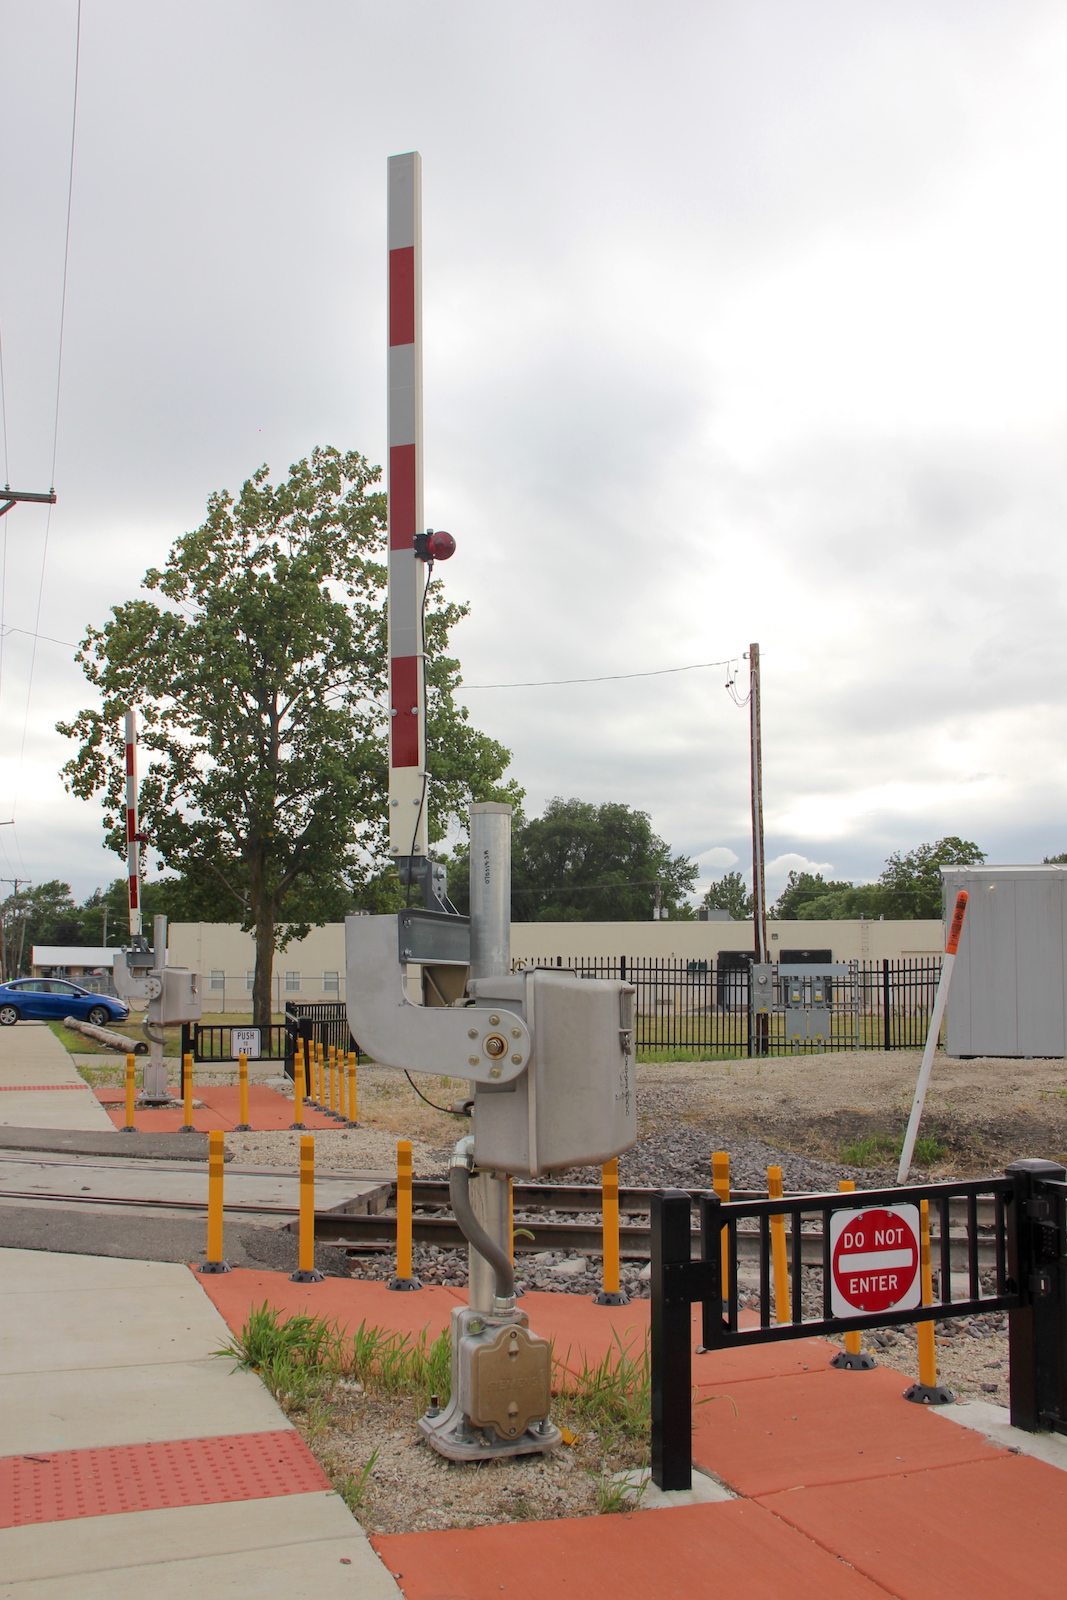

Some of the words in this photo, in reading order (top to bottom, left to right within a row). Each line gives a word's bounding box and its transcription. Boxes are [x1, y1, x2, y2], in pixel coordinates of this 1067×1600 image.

[237, 1032, 255, 1040] PUSH
[843, 1231, 865, 1249] DO
[874, 1228, 904, 1246] NOT
[849, 1274, 898, 1294] ENTER
[487, 1376, 539, 1392] SIEMENS
